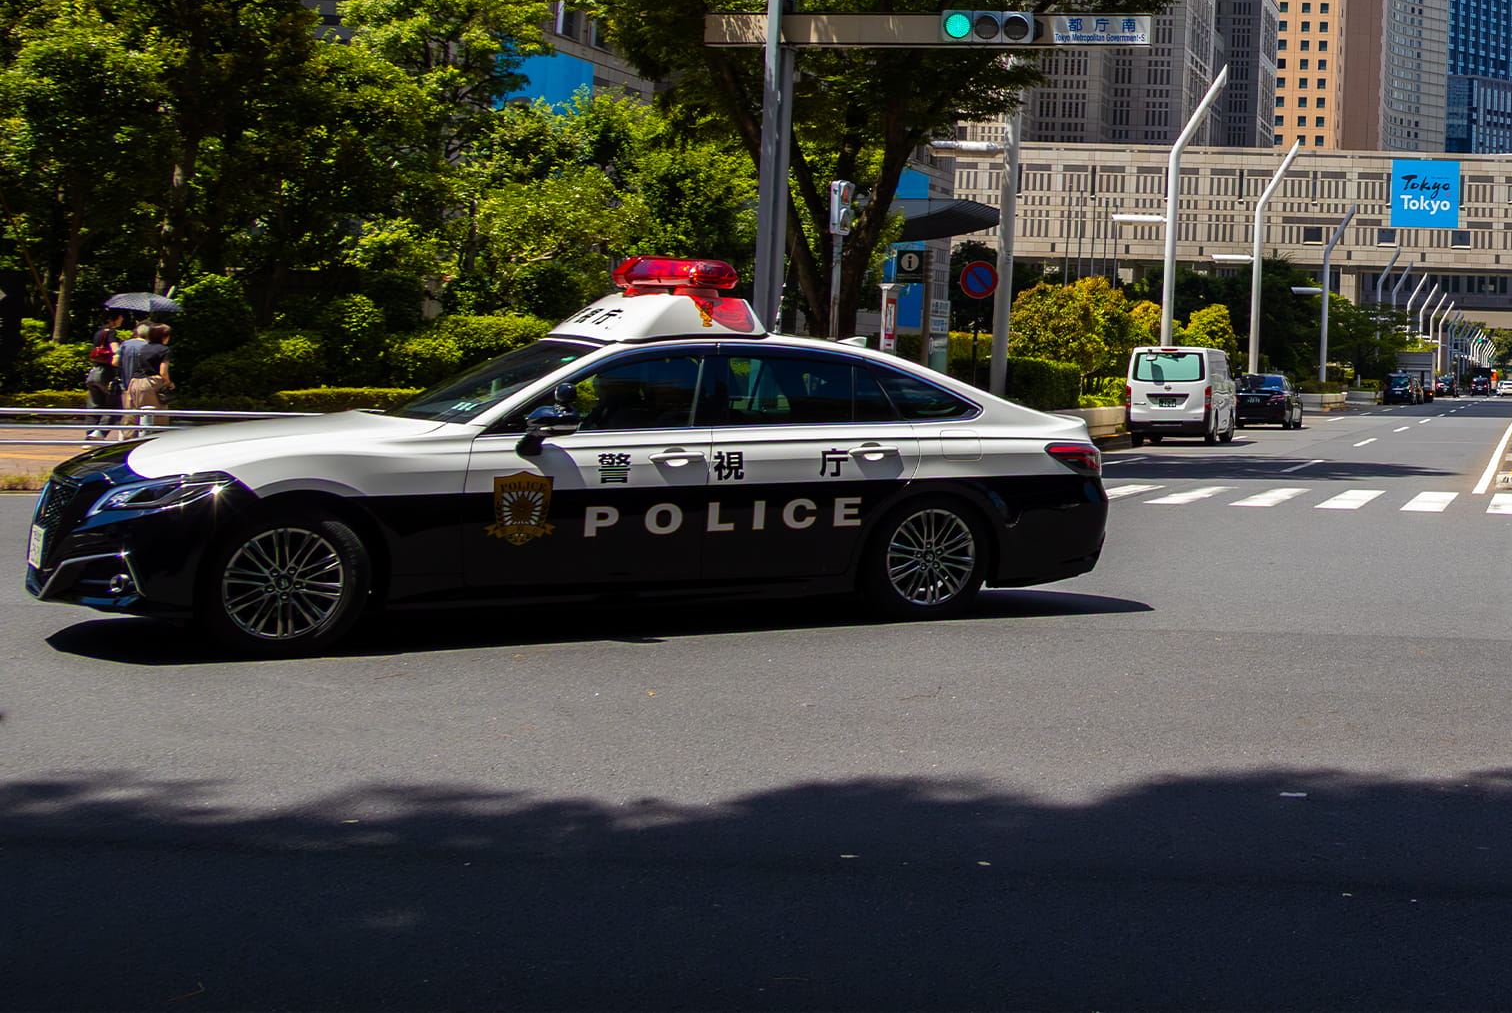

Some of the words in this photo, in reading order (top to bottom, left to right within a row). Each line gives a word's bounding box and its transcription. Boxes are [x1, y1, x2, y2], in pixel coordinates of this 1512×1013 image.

[1068, 18, 1136, 32] 都庁南
[1055, 33, 1071, 43] Tokyo
[1072, 34, 1105, 43] Metropolitan
[1401, 174, 1451, 199] Tokyo
[1400, 195, 1451, 215] Tokyo
[597, 448, 849, 484] 警視庁
[500, 481, 547, 492] POLICE
[583, 497, 863, 537] POLICE
